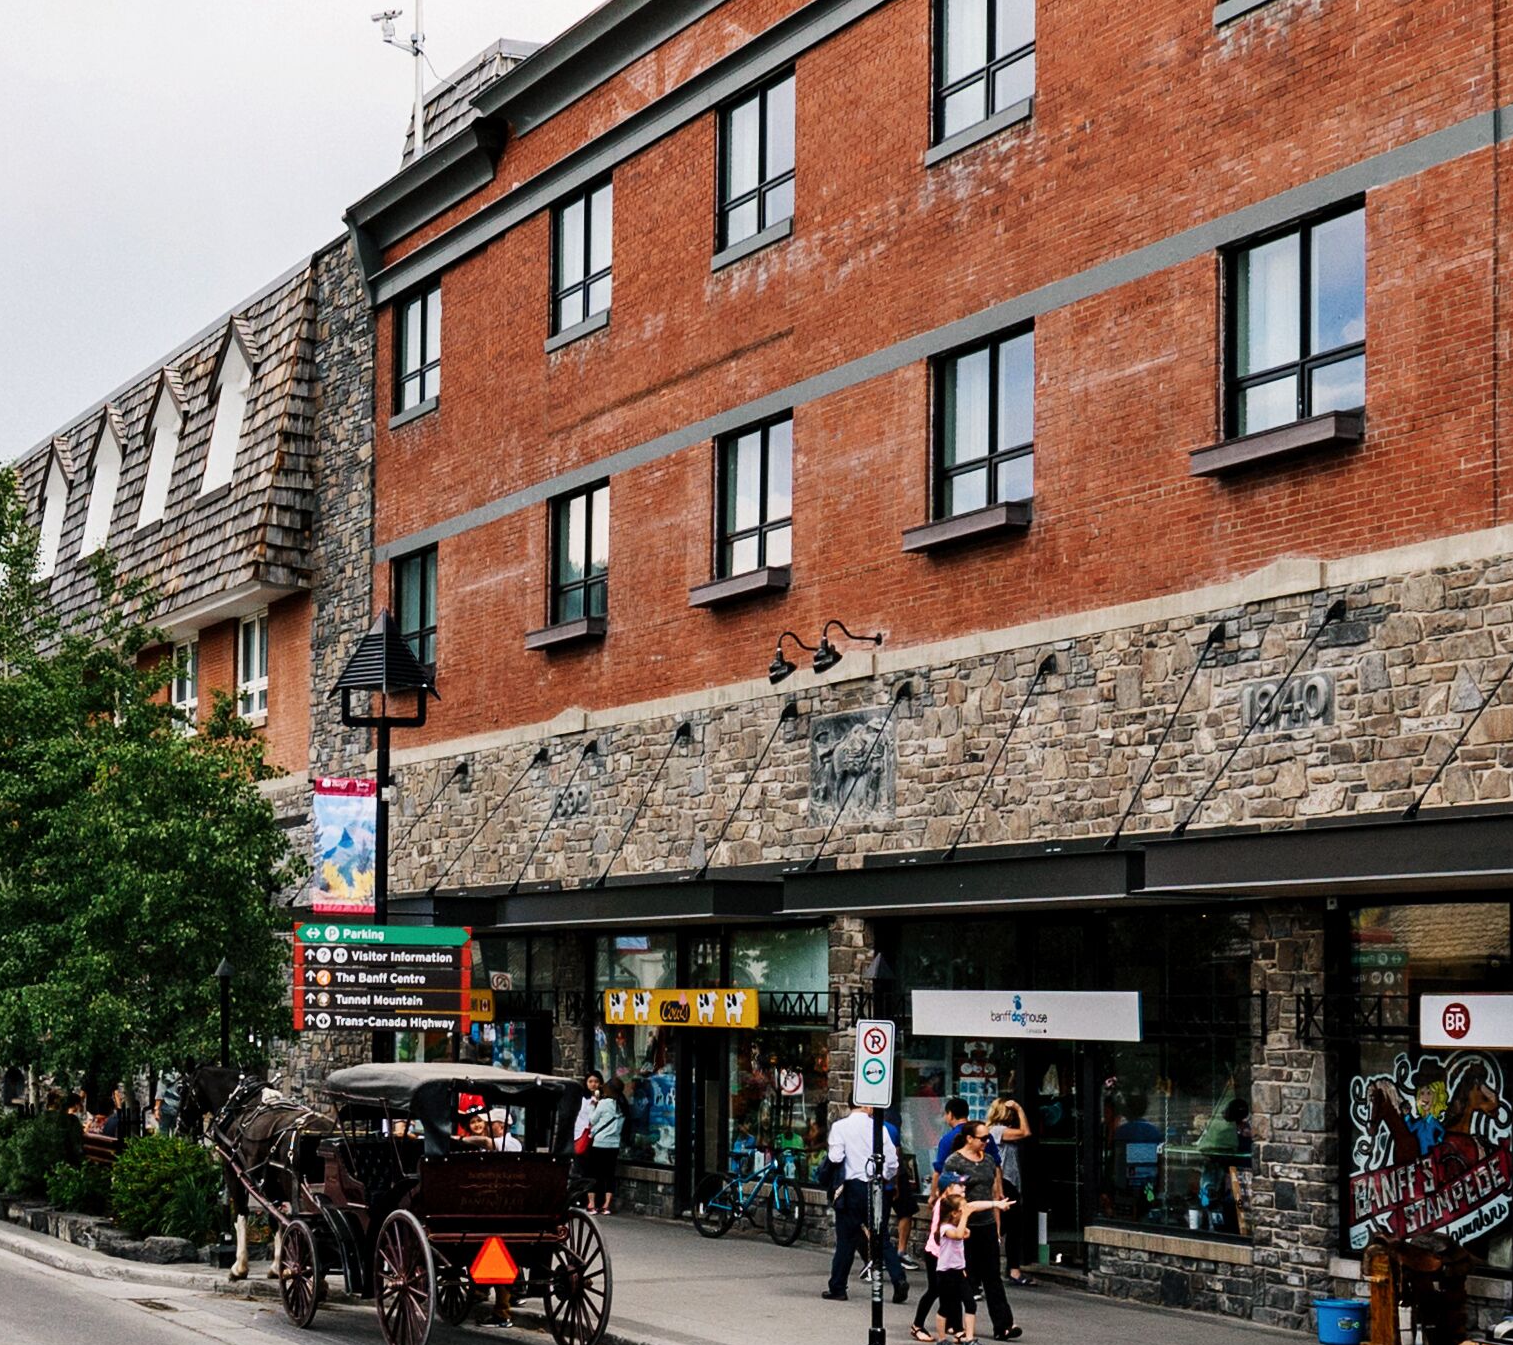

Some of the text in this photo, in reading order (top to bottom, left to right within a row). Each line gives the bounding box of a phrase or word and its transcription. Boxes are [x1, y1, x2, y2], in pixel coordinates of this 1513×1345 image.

[343, 929, 385, 942] Parking
[351, 951, 453, 963] Visitor Information
[335, 972, 426, 984] The Banff Centre
[335, 994, 423, 1006] Tunnel Mountain
[334, 1016, 455, 1030] Trans-Canada Highway
[1445, 1013, 1466, 1031] BR
[1354, 1156, 1436, 1220] BANFF'S
[1403, 1156, 1507, 1234] STAMPEDE
